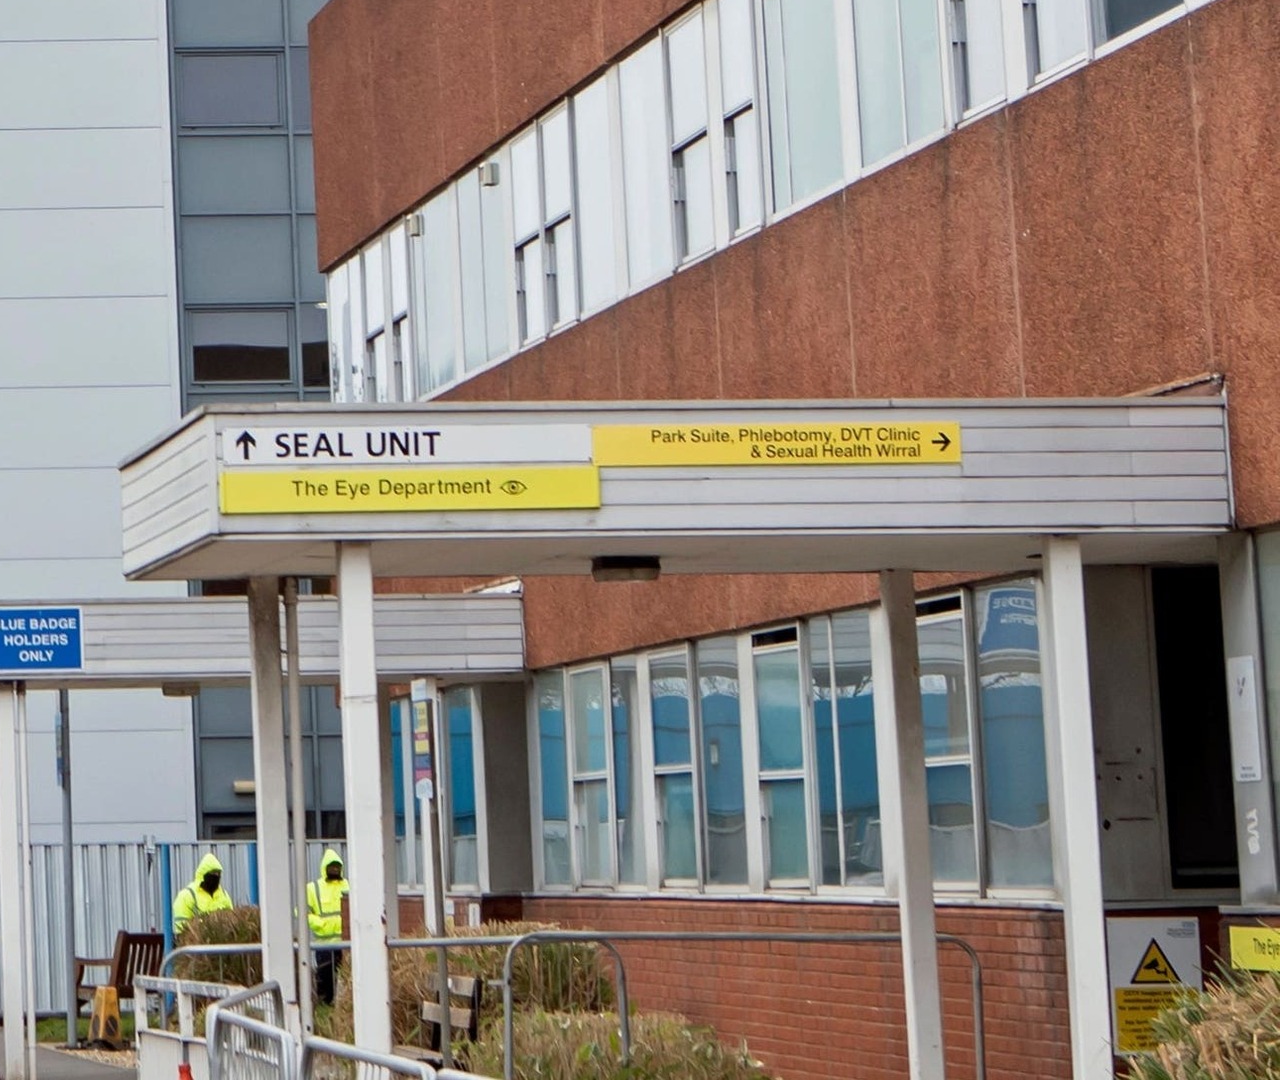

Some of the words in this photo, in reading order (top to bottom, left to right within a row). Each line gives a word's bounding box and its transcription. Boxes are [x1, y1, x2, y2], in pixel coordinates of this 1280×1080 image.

[651, 429, 687, 443] Park
[690, 428, 735, 443] Suite,
[739, 428, 837, 444] Phlebotomy,
[840, 427, 873, 441] DVT
[877, 427, 920, 441] Clinic
[275, 432, 353, 458] SEAL
[366, 431, 441, 456] UNIT
[750, 444, 762, 458] &
[765, 444, 818, 458] Sexual
[822, 443, 872, 458] Health
[875, 443, 921, 457] Wirral
[292, 480, 329, 496] The
[335, 480, 370, 500] Eye
[378, 478, 492, 499] Department
[29, 617, 77, 630] BADGE
[3, 634, 69, 647] HOLDERS
[18, 650, 54, 662] ONLY
[1252, 937, 1266, 956] The
